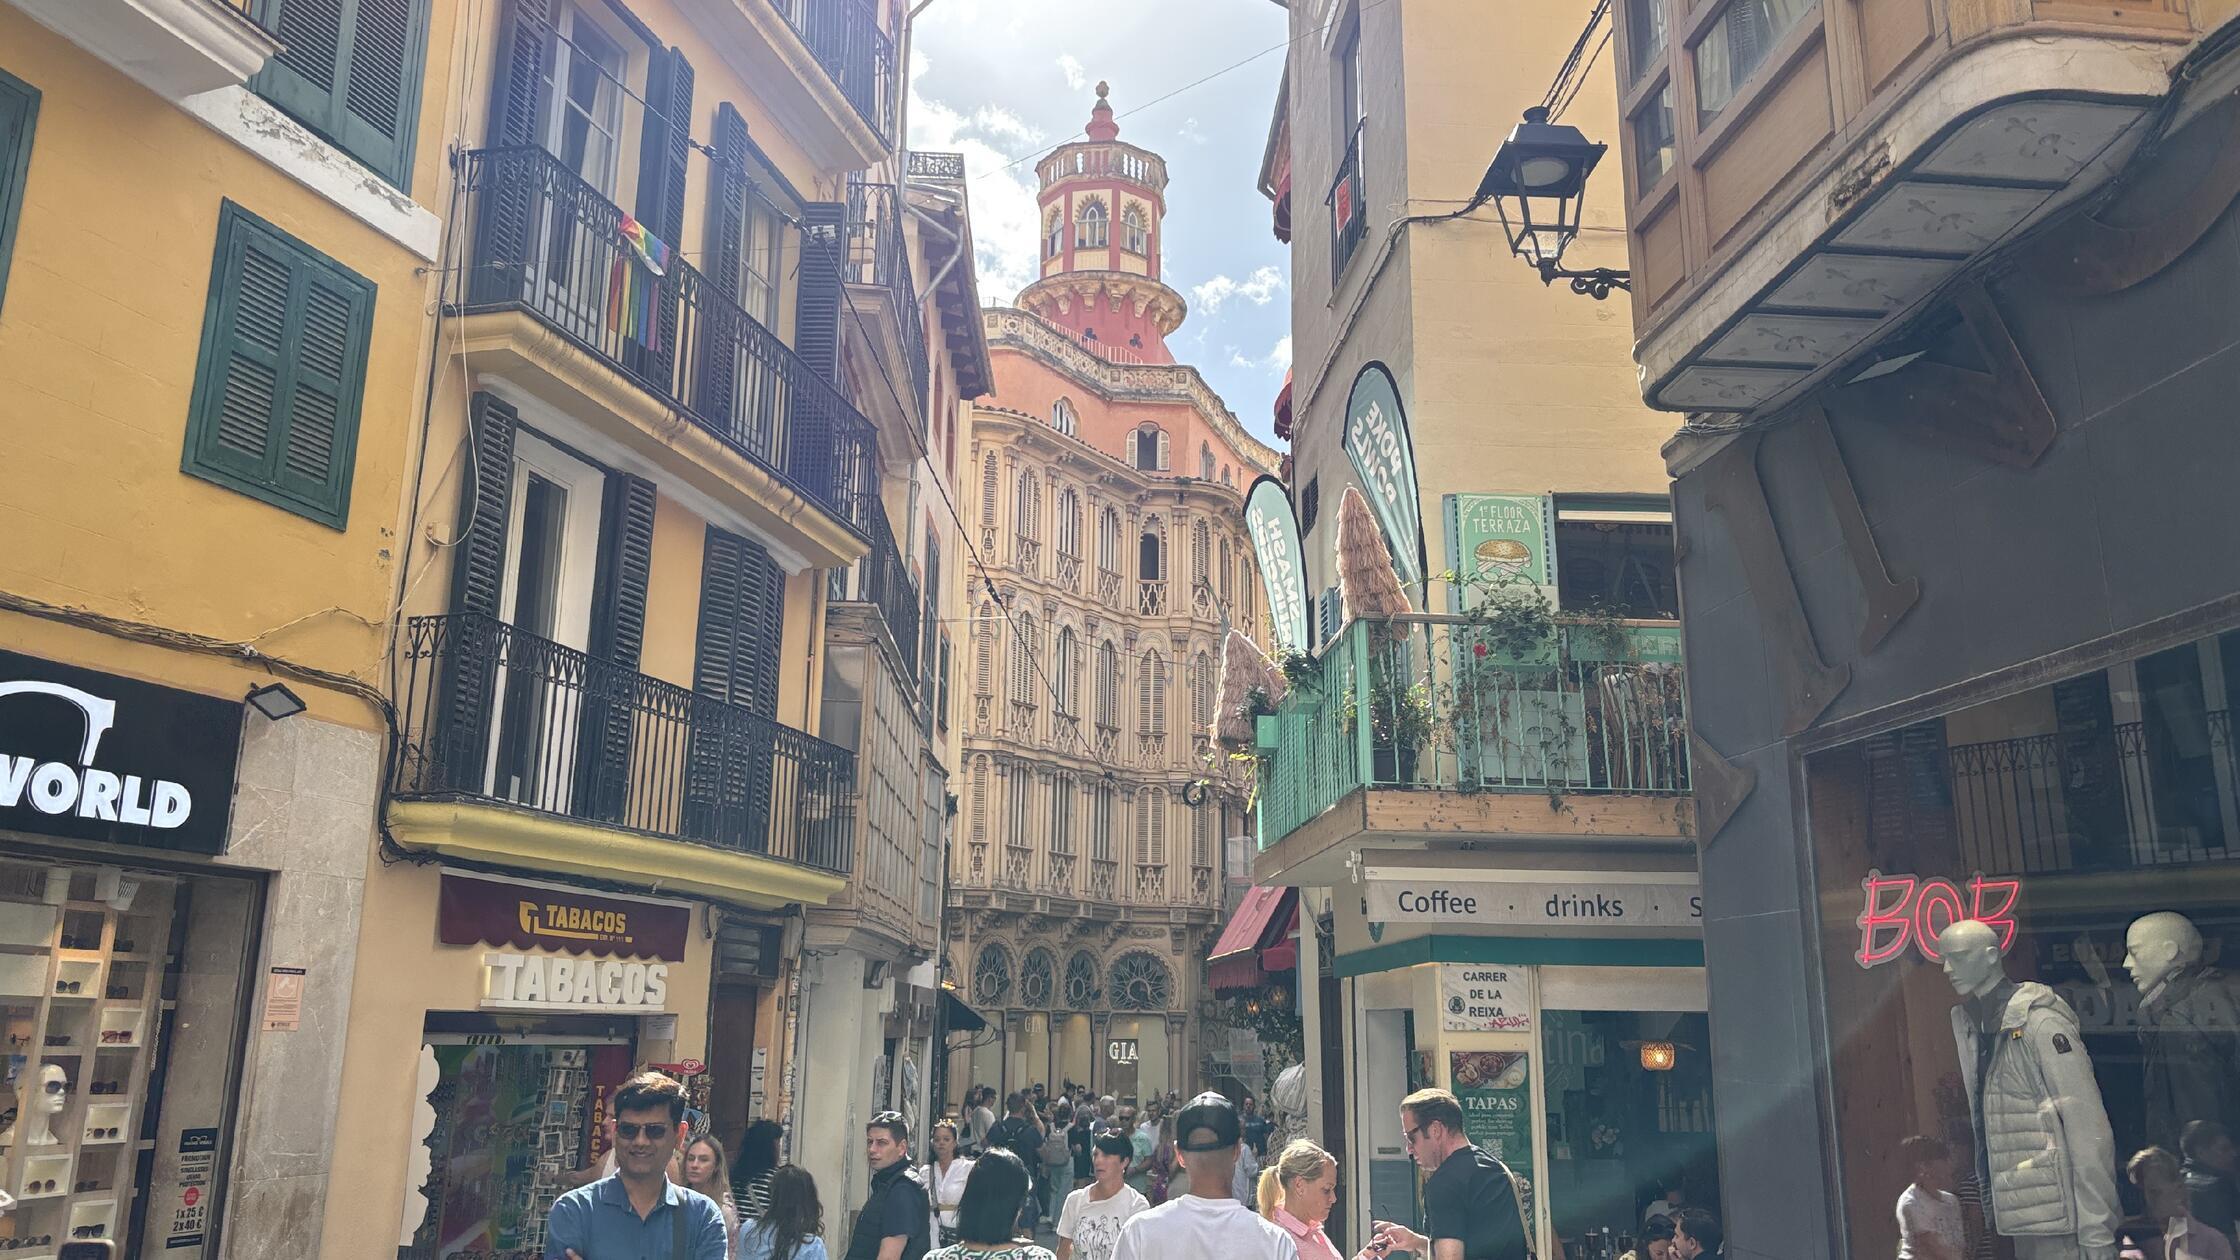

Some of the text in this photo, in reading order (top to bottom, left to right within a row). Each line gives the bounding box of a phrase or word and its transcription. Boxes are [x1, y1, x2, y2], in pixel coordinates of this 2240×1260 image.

[1490, 505, 1525, 519] FLOOR
[1472, 518, 1531, 534] TERRAZA
[1398, 890, 1477, 914] Coffee
[1545, 894, 1624, 918] drinks
[546, 904, 627, 934] TABACOS
[1858, 874, 2020, 965] BOB
[496, 953, 668, 1005] TABACOS
[1463, 971, 1508, 982] CARRER
[1470, 989, 1502, 1000] DE LA
[1468, 1006, 1505, 1018] REIXA
[1108, 1041, 1139, 1060] GIA
[1465, 1096, 1518, 1111] TAPAS
